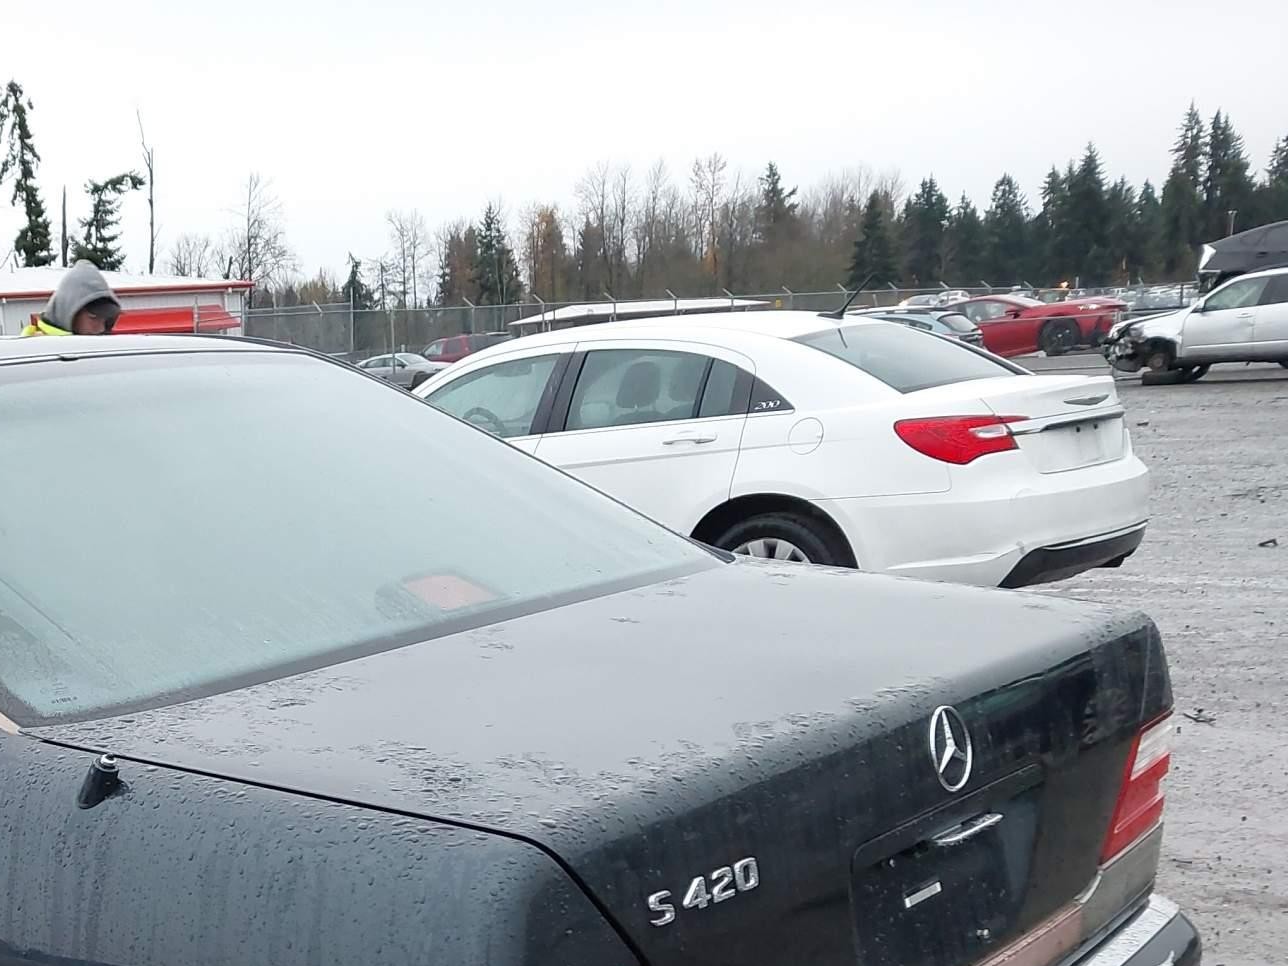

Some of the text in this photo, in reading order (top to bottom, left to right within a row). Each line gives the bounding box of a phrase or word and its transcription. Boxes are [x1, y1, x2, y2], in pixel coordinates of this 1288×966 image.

[754, 400, 781, 410] 200
[648, 857, 760, 926] S 420
